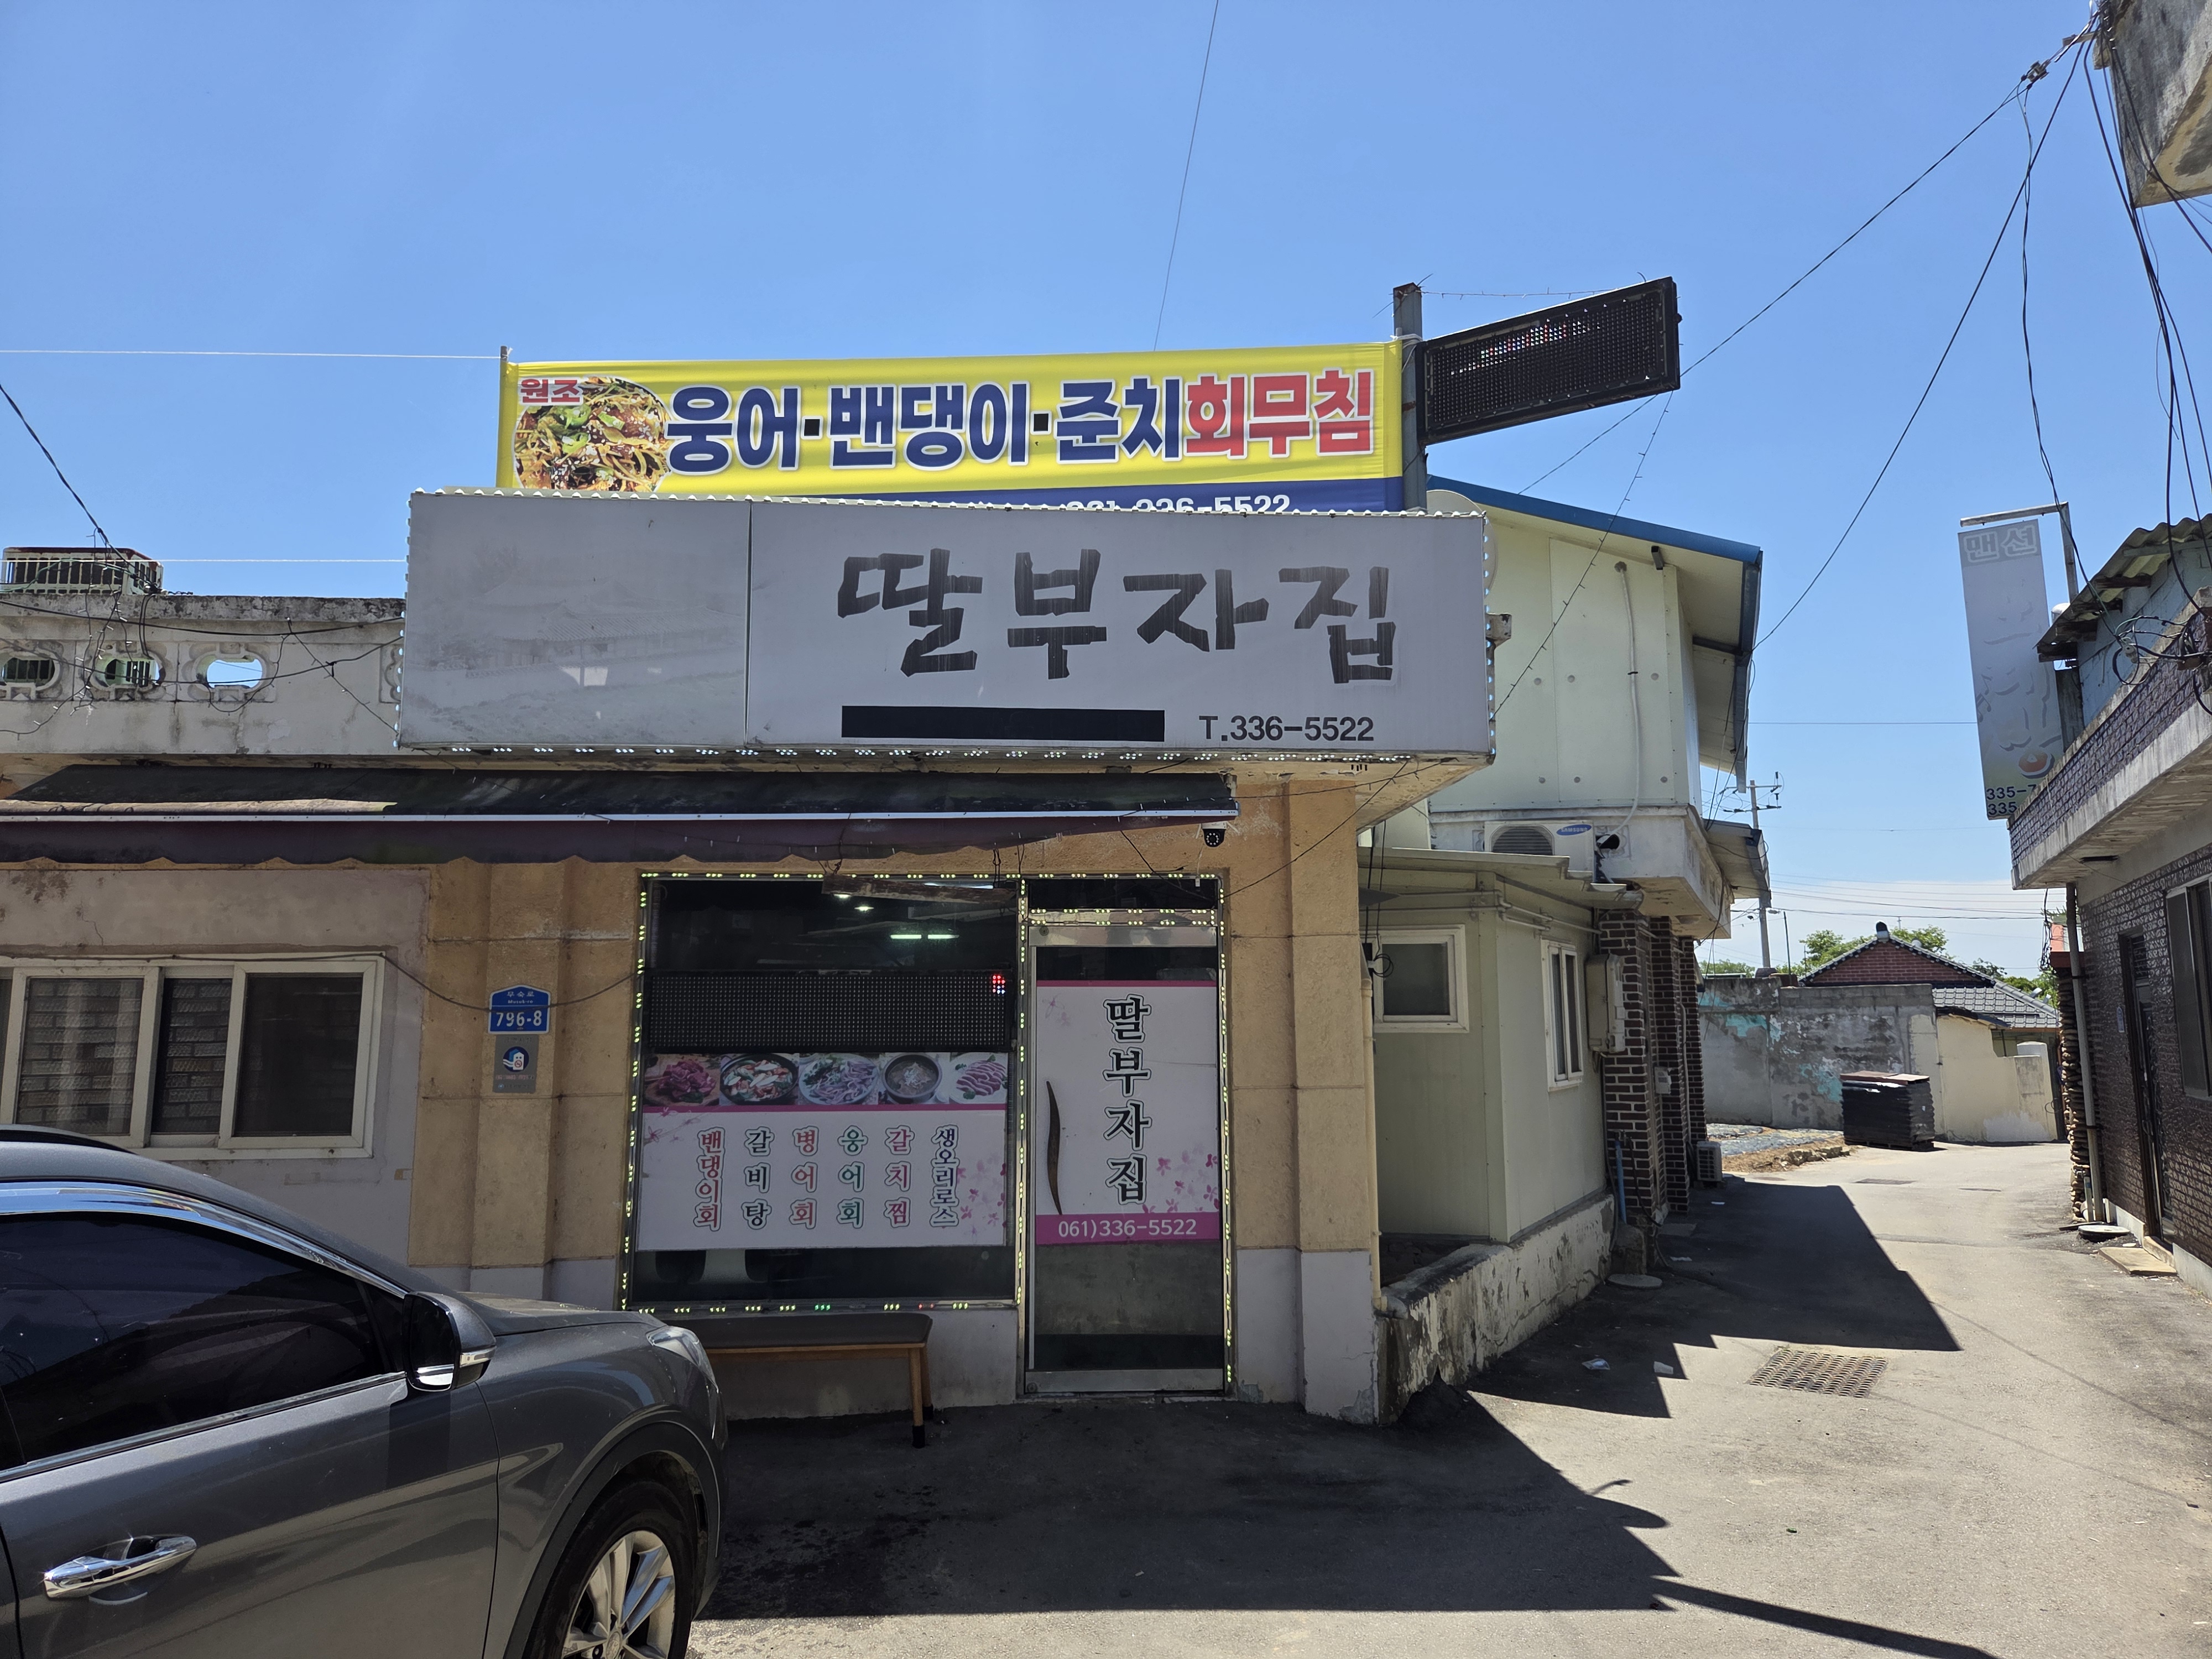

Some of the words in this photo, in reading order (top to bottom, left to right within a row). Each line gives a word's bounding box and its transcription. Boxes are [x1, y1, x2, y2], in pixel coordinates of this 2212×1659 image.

[520, 378, 580, 403] 원조
[1964, 525, 2037, 562] 맨션
[837, 547, 1397, 684] 딸부자집
[1198, 715, 1375, 742] T.336-5522
[496, 1010, 542, 1027] 796-8
[1105, 996, 1150, 1203] 딸부자집
[697, 1129, 722, 1229] 밴댕이회
[744, 1129, 770, 1228] 갈비탕
[792, 1128, 816, 1227] 병어회
[840, 1128, 865, 1226] 웅어회
[886, 1128, 912, 1225] 갈치찜
[932, 1127, 957, 1225] 생오리로스
[1058, 1219, 1197, 1239] 061)336-5522
